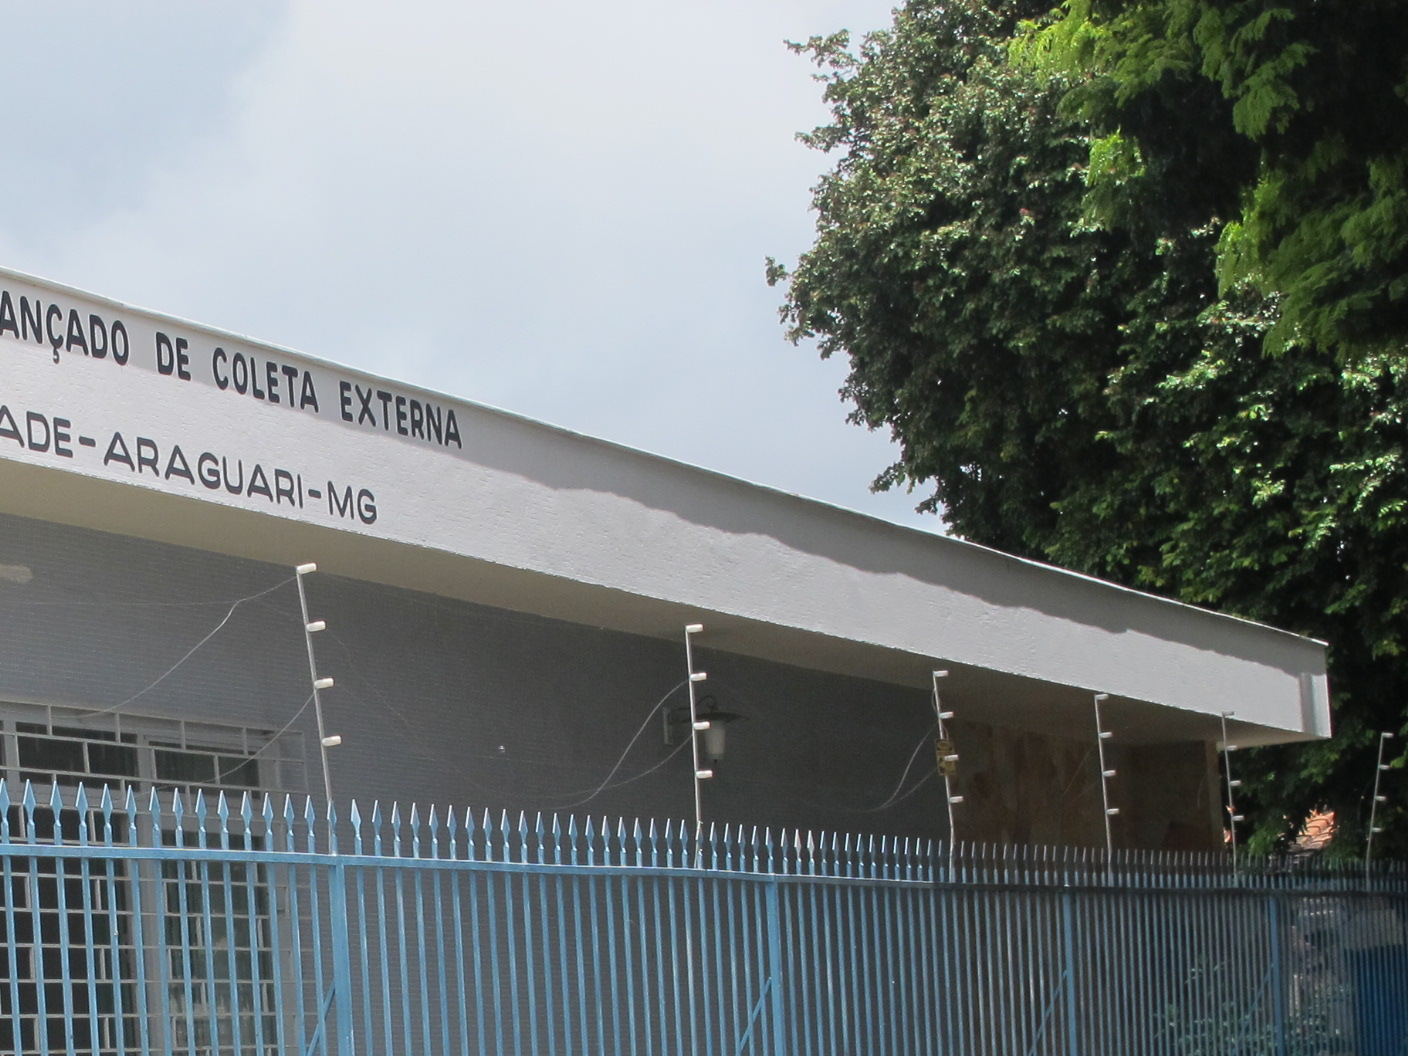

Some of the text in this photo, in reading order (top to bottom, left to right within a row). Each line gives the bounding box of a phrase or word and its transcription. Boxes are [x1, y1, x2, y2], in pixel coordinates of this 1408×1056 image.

[155, 331, 192, 381] DE
[212, 347, 319, 414] COLETA
[339, 380, 463, 450] EXTERNA
